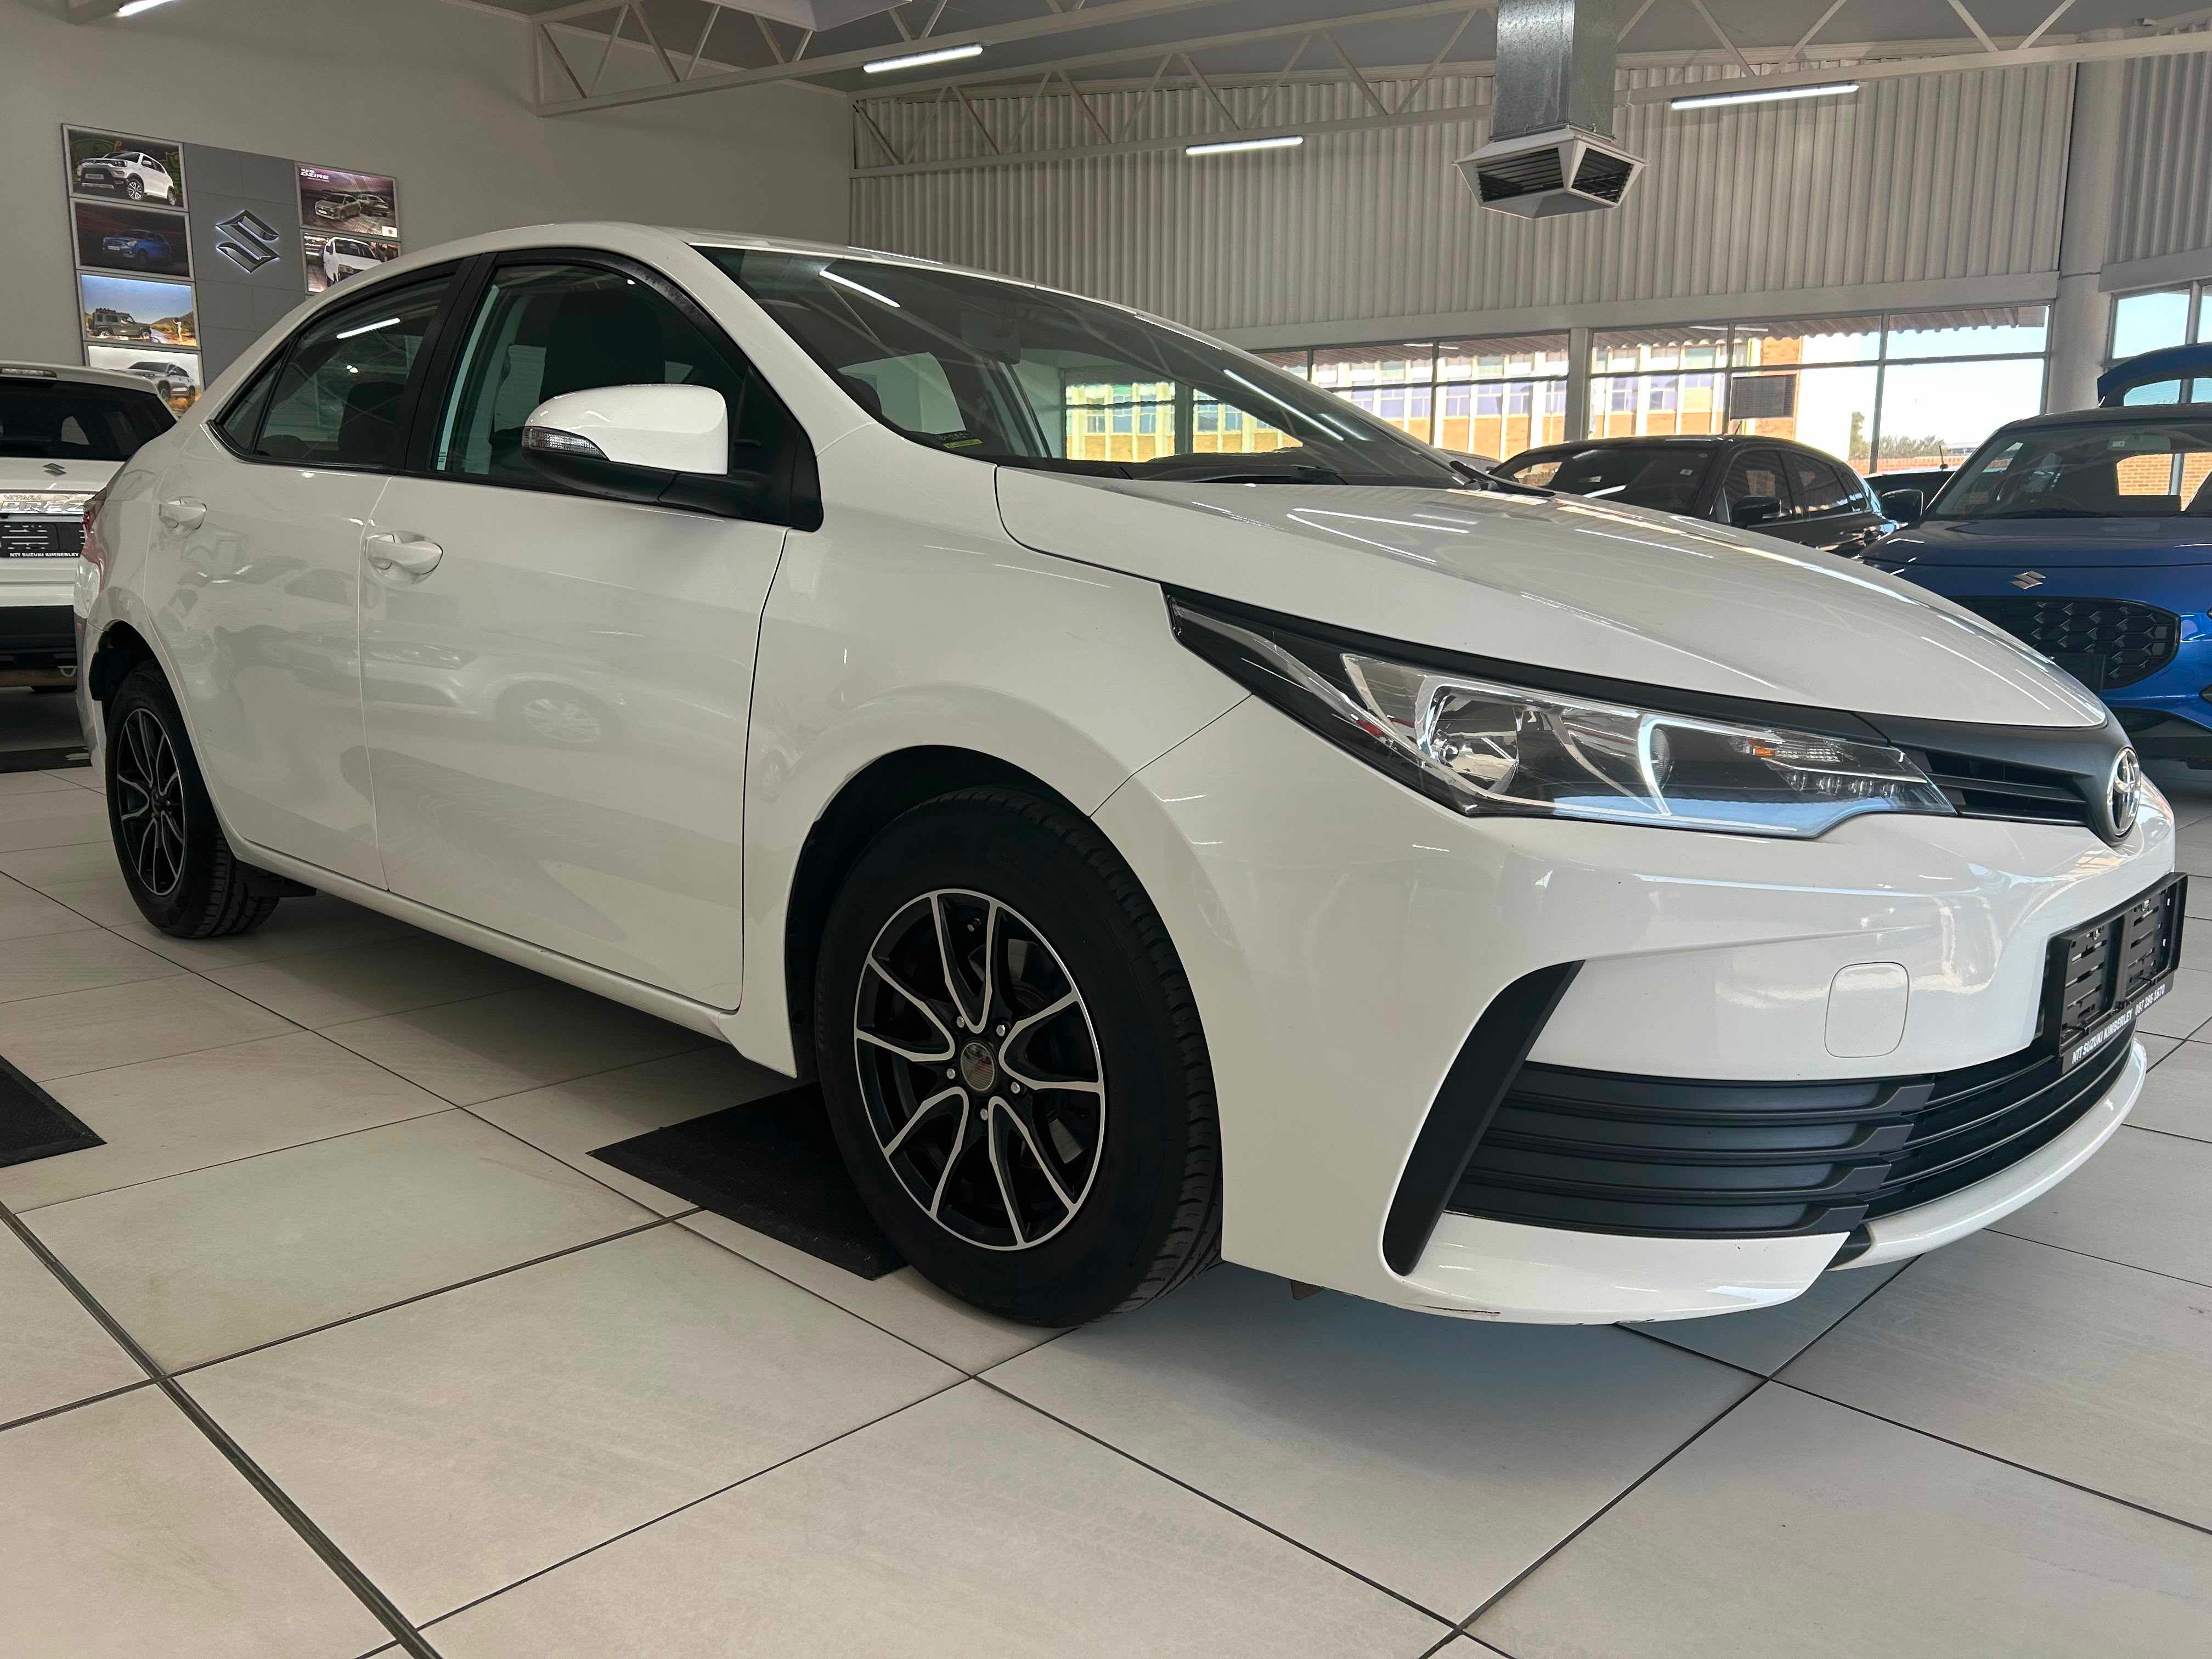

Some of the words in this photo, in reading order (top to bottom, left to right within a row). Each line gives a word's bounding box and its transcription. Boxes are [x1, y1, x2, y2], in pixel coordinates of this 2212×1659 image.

[2072, 1045, 2083, 1064] NTT
[2083, 1030, 2103, 1056] SUZUKI
[2103, 1008, 2133, 1040] KIMBERLEY
